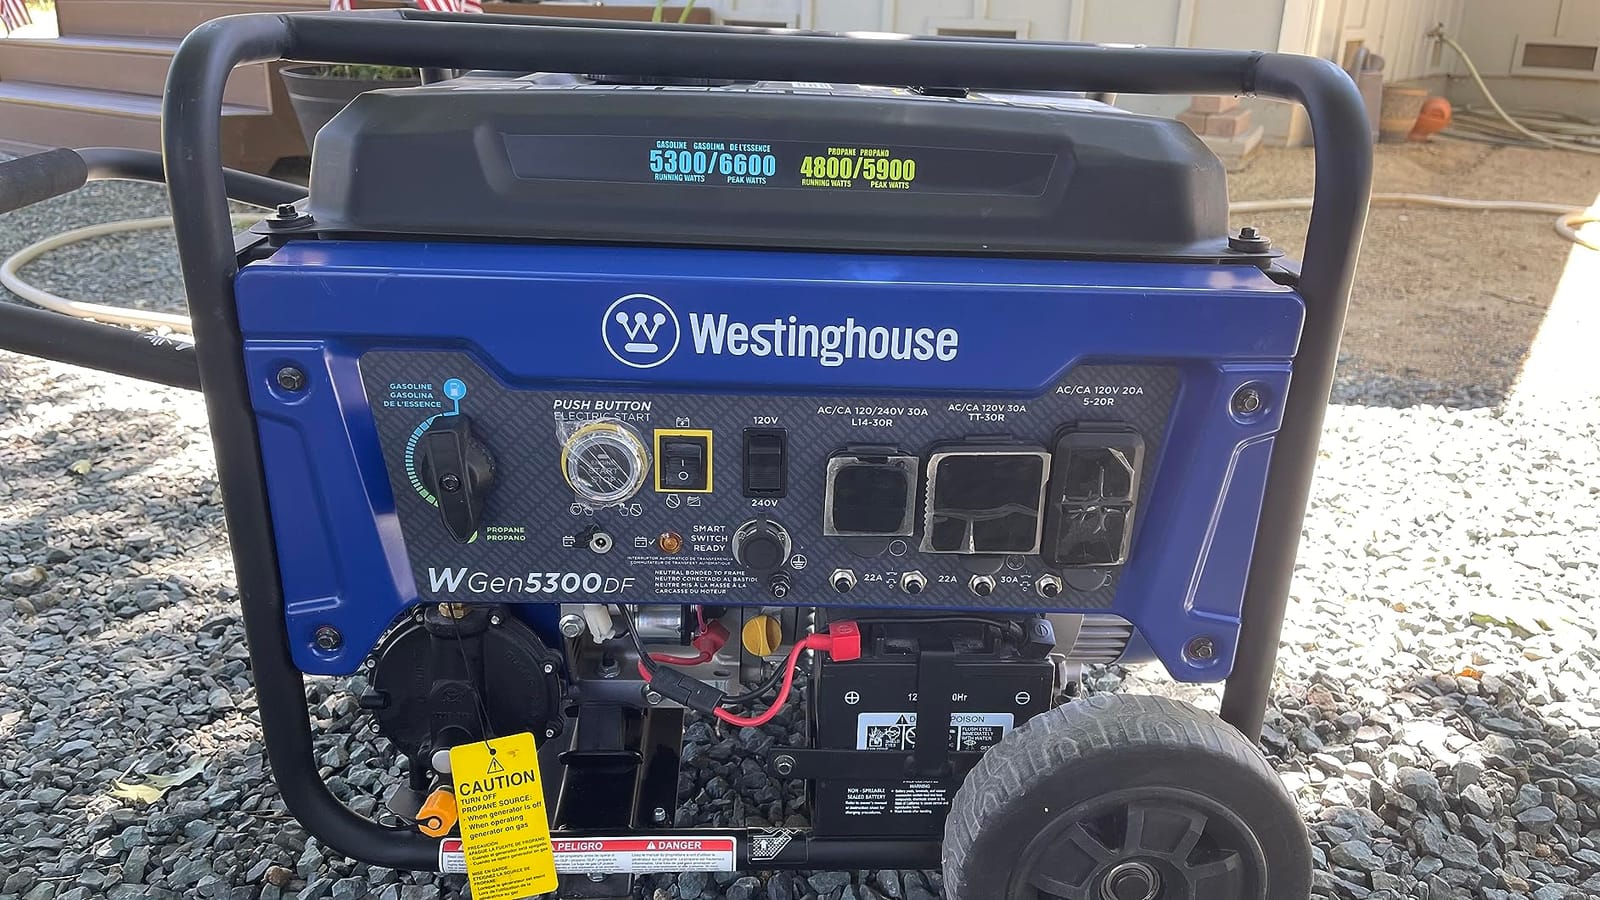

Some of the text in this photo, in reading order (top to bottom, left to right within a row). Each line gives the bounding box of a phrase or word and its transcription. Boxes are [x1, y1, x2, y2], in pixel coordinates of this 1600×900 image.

[656, 141, 687, 150] GASOLINE
[693, 142, 725, 151] GASOLINA
[828, 147, 890, 157] PROPANE PROPANO
[650, 150, 776, 176] 5300/6600
[800, 155, 916, 182] 4800/5900
[654, 173, 705, 182] RUNNING WATTS
[727, 176, 766, 185] PEAK WATTS
[801, 179, 852, 188] RUNNING WATTS
[888, 181, 910, 189] WATTS
[689, 313, 959, 367] Westinghouse
[389, 383, 432, 391] GASOLINE
[1056, 386, 1144, 395] AC/CA 120V 20A
[390, 391, 433, 399] GASOLINA
[383, 400, 442, 408] DE L'ESSENCE
[553, 400, 651, 411] PUSH BUTTON
[1083, 397, 1114, 406] 5-20R
[817, 406, 929, 416] AC/CA 120/240V 30A
[948, 403, 1027, 413] AC/CA 120V 30A
[554, 412, 651, 422] ELECTRIC START
[753, 416, 778, 424] 120V
[968, 413, 1005, 422] TT-30R
[851, 418, 893, 427] L14-30R
[751, 499, 778, 507] 240V
[486, 526, 525, 534] PROPANE
[486, 534, 526, 542] PROPANO
[693, 544, 726, 552] READY
[864, 574, 883, 582] 22A
[938, 575, 957, 583] 22A
[1000, 576, 1019, 584] 30A
[908, 693, 968, 701] 12 0Hr
[459, 769, 536, 796] CAUTION
[460, 793, 497, 805] TURN OFF
[461, 795, 532, 814] PROPANE SOURCE:
[467, 812, 488, 821] When
[489, 804, 522, 818] generator
[532, 801, 542, 809] off
[468, 814, 524, 831] When operating
[469, 827, 503, 840] generator
[515, 823, 529, 831] gas
[557, 842, 603, 851] PELIGRO
[658, 841, 701, 850] DANGER
